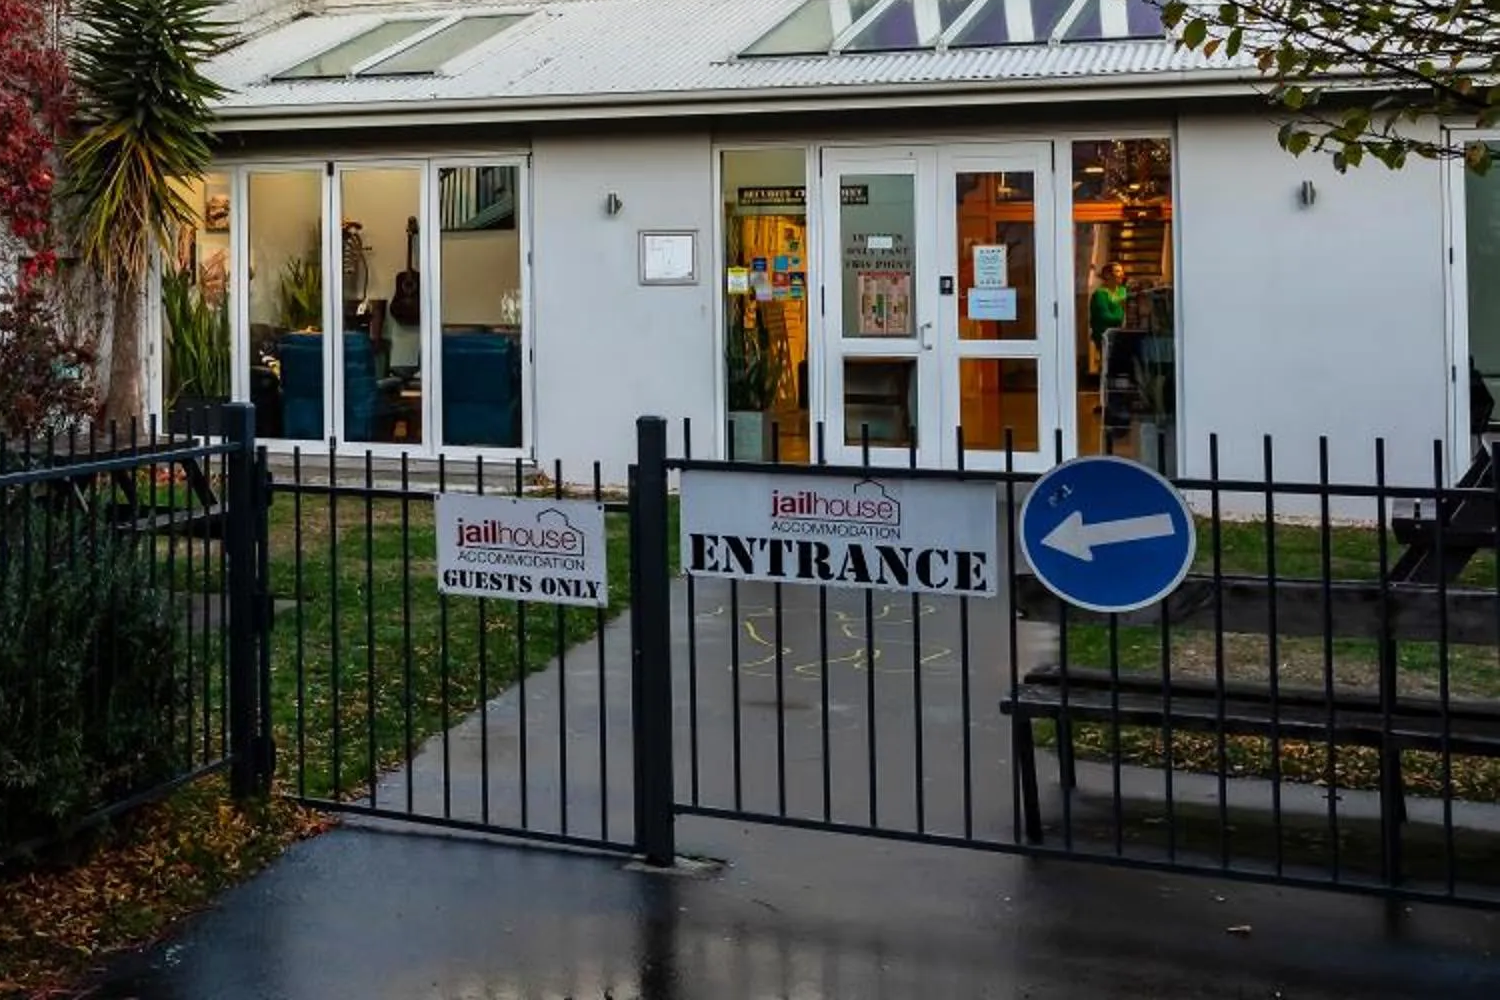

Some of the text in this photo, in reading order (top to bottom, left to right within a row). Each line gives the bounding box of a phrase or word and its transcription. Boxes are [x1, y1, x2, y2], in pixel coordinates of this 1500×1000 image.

[771, 490, 893, 520] jailhouse
[456, 518, 577, 550] jailhouse
[771, 521, 901, 539] ACCOMMODATION
[457, 551, 585, 571] ACCOMMODATION
[688, 533, 988, 592] ENTRANCE
[443, 568, 601, 599] GUESTS ONLY
